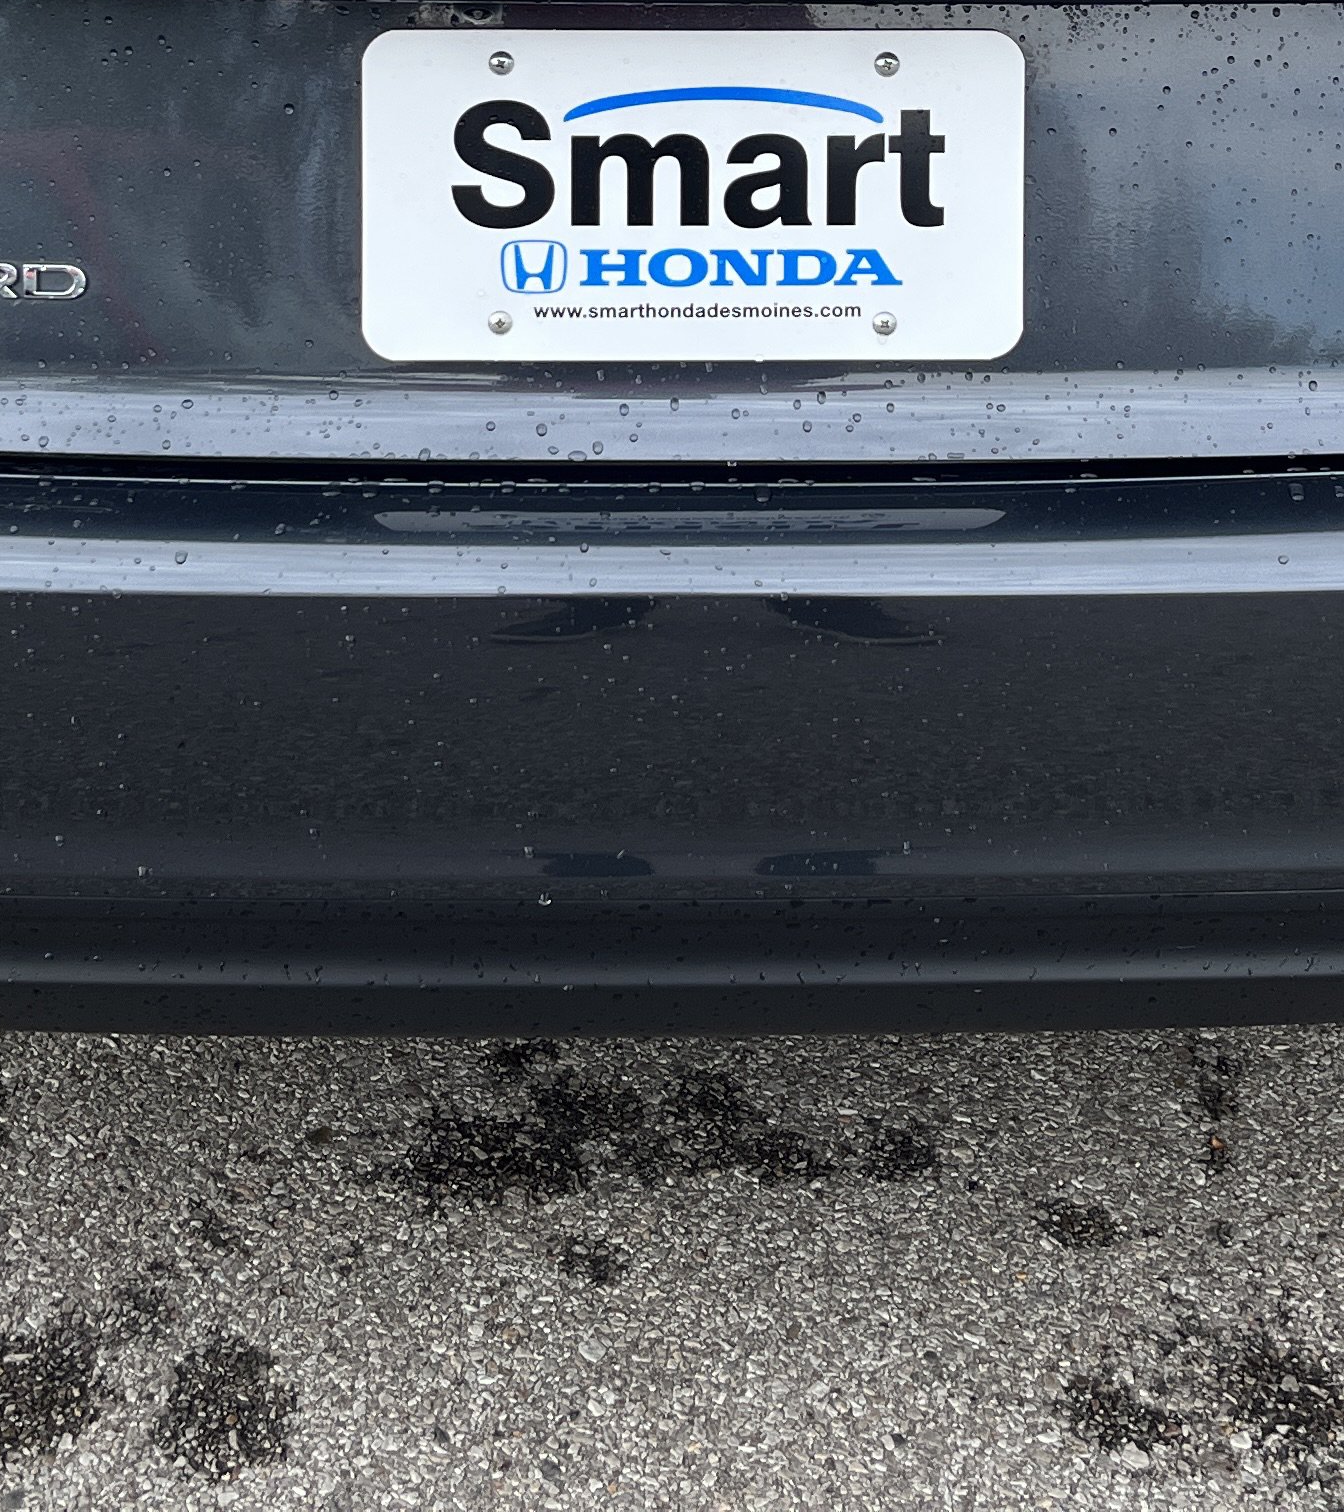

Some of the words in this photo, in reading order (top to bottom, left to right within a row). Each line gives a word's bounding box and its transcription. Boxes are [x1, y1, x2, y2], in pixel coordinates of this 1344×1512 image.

[452, 100, 946, 229] Smart
[580, 248, 903, 287] HONDA
[534, 303, 862, 319] www.smarthondadesmoines.com
